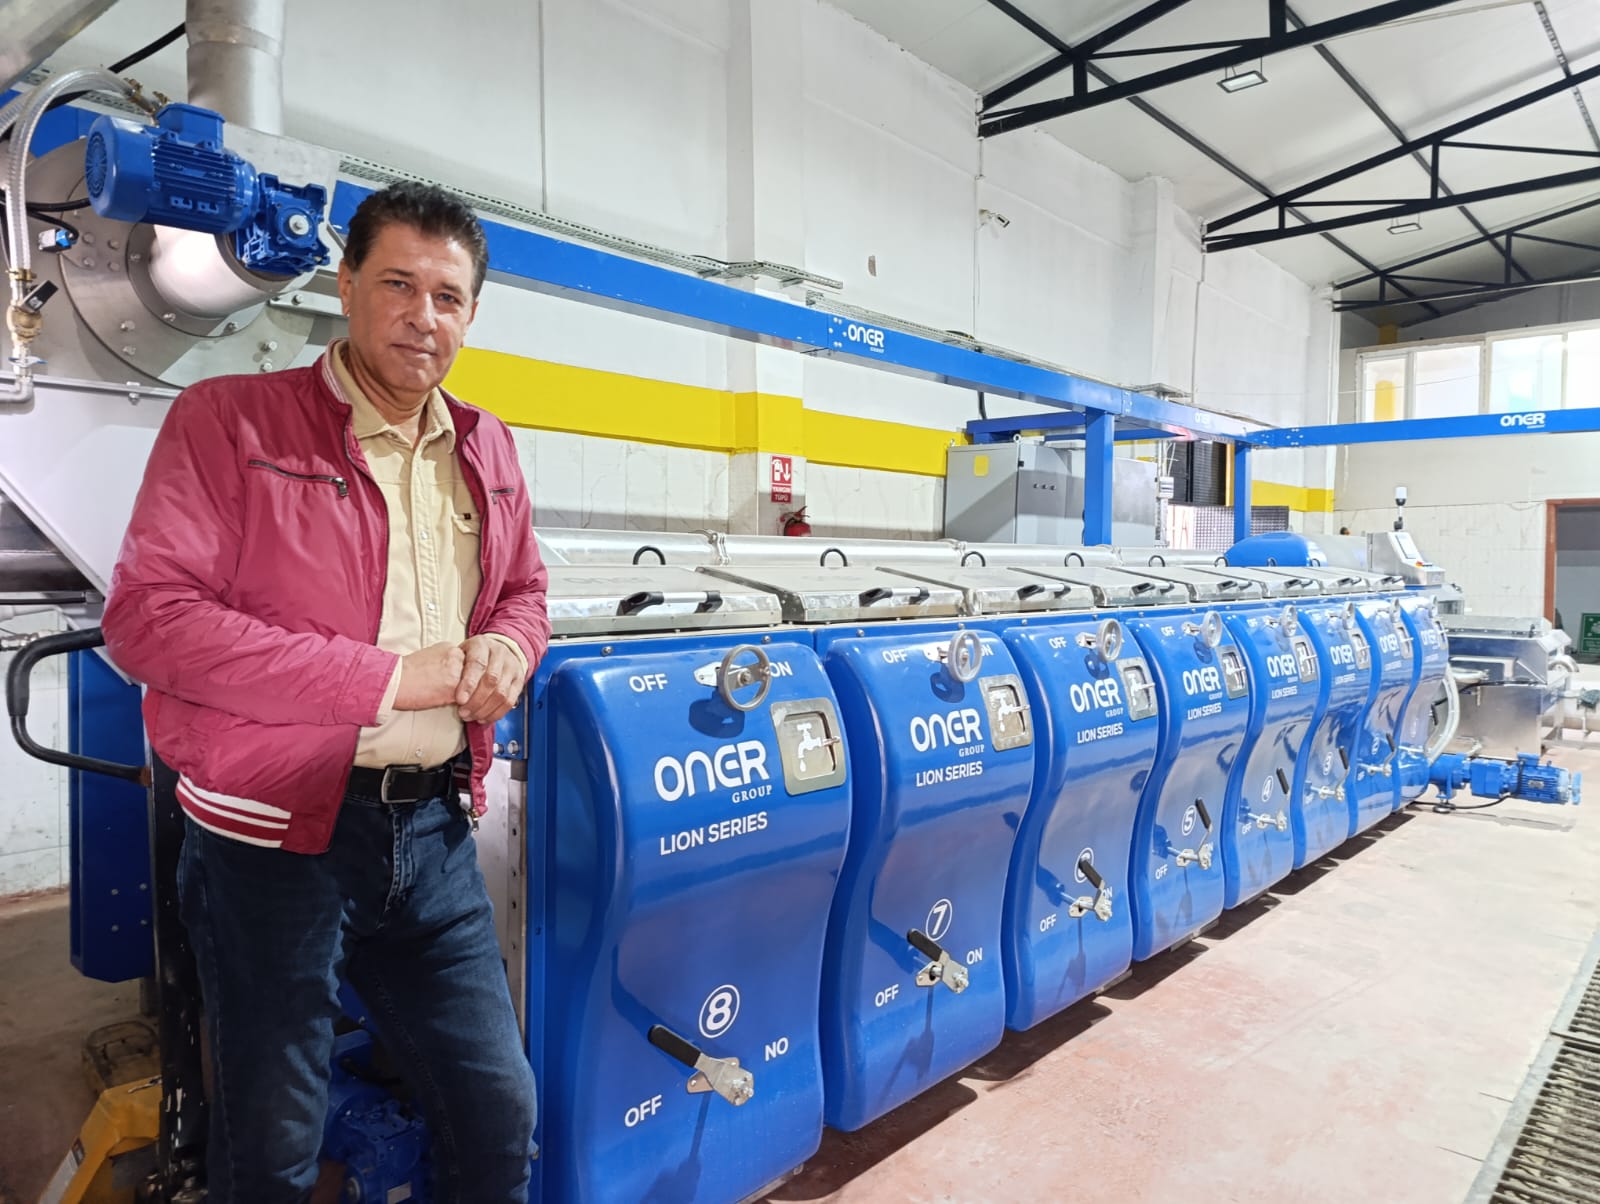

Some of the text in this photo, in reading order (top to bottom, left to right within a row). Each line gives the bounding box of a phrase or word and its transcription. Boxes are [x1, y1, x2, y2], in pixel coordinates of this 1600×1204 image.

[848, 324, 884, 348] ONER
[1500, 412, 1546, 427] ONER
[1049, 637, 1067, 649] OFF
[882, 650, 907, 664] OFF
[1266, 653, 1297, 678] ONER
[770, 661, 793, 678] ON
[629, 673, 668, 693] OFF
[1183, 667, 1221, 696] ONER
[1070, 678, 1121, 713] ONER
[910, 708, 983, 752] ONER
[1077, 723, 1123, 744] LION SERIES
[959, 744, 985, 757] GROUP
[654, 740, 770, 802] ONER
[916, 761, 983, 787] LION SERIES
[731, 785, 772, 804] GROUP
[660, 811, 768, 855] LION SERIES
[1155, 863, 1168, 880] OFF
[933, 904, 948, 935] 7
[1040, 914, 1056, 932] OFF
[966, 947, 983, 964] ON
[875, 984, 899, 1007] OFF
[706, 992, 732, 1031] 8
[764, 1037, 789, 1061] NO
[624, 1094, 662, 1127] OFF
